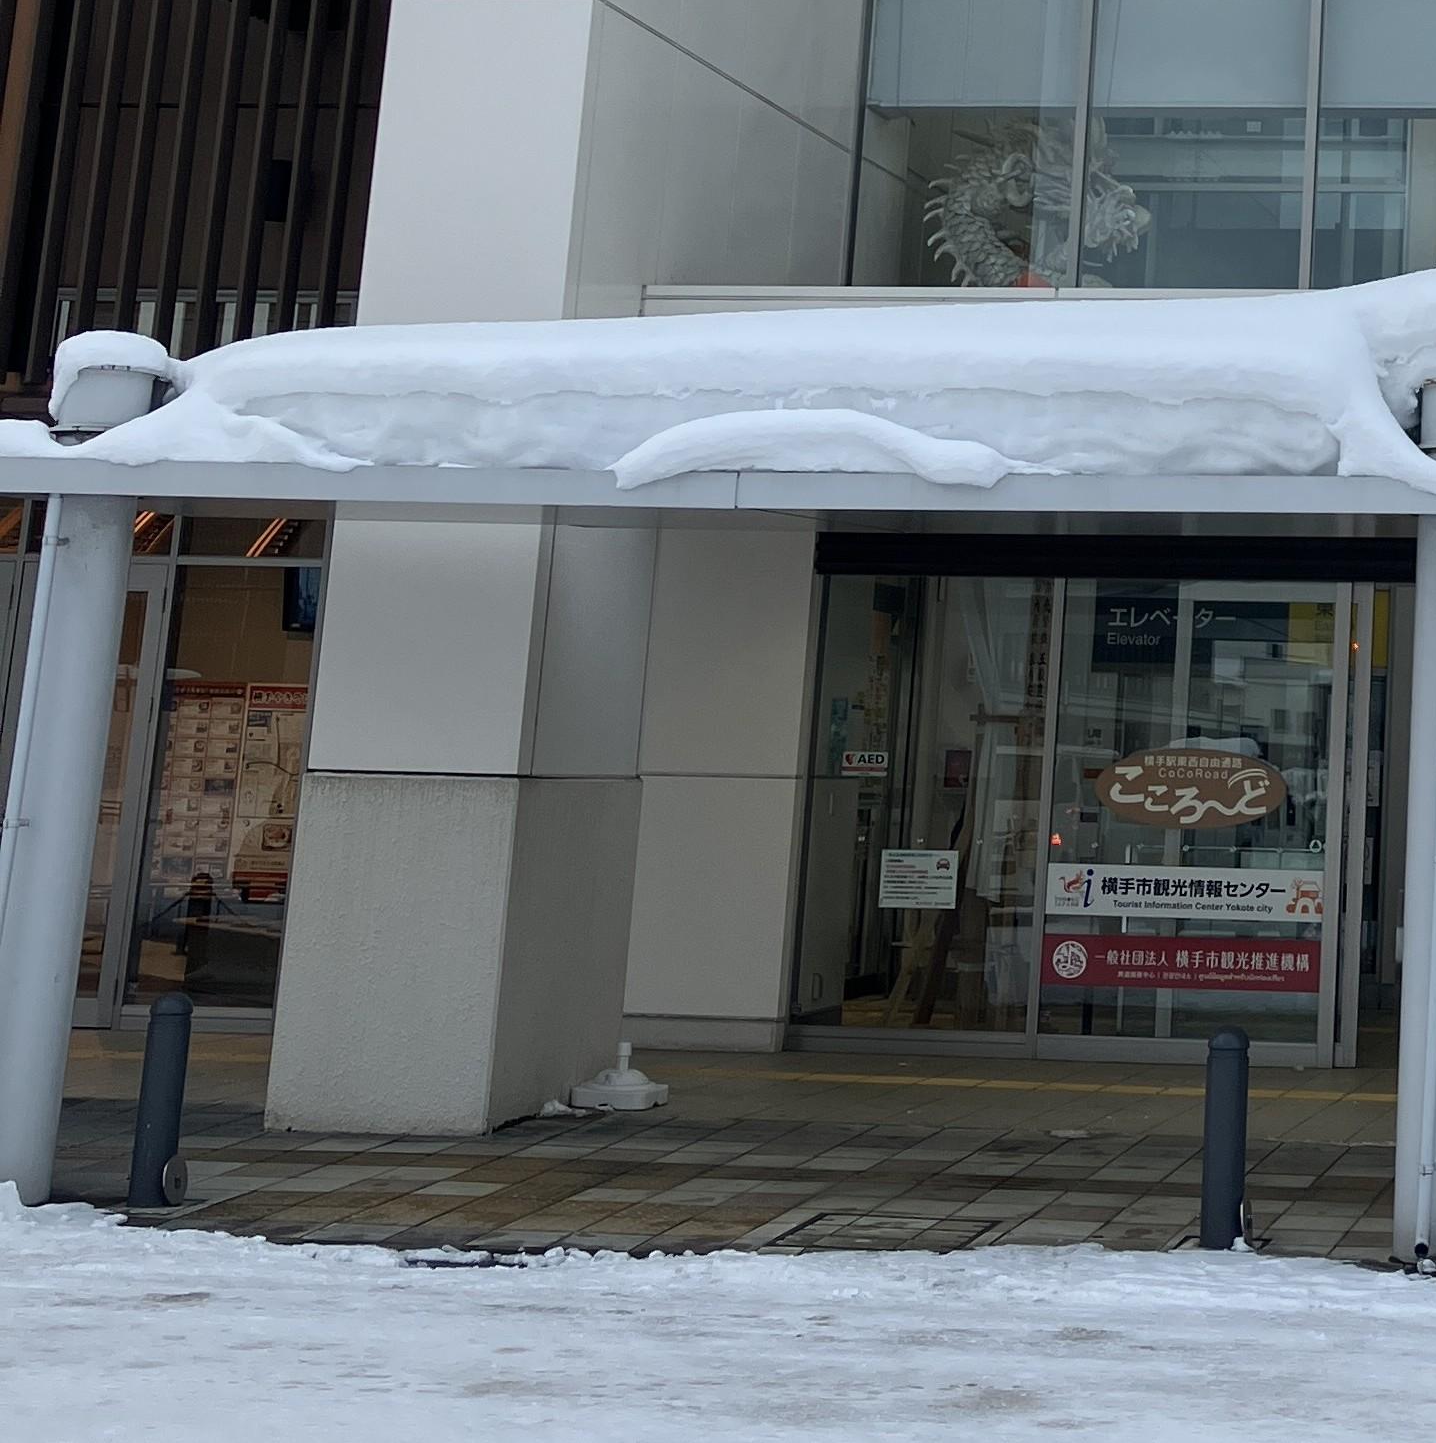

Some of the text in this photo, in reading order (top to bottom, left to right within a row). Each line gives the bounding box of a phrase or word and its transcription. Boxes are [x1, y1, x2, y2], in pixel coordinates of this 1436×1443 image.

[1107, 607, 1237, 629] エレベター
[1106, 632, 1161, 646] Elevator
[857, 753, 885, 765] AED
[1158, 767, 1230, 780] CoCoRoad
[1100, 876, 1286, 899] 横手市観光情報センター
[1112, 899, 1274, 914] Tourist Information Center Yokote city
[1094, 949, 1310, 973] 一般社団法人 横手市観光推進機構
